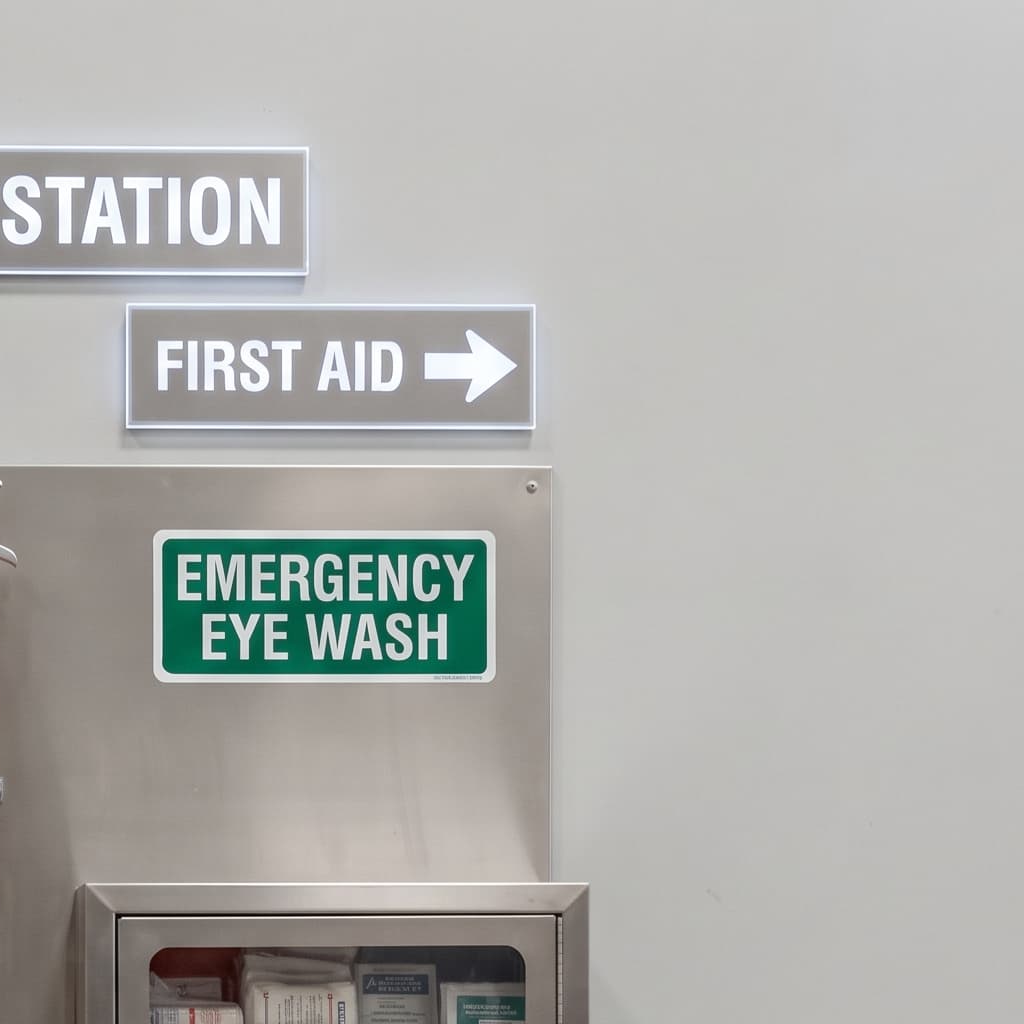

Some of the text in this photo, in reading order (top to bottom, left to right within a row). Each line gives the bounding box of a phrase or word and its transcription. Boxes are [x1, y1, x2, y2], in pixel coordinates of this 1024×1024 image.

[1, 175, 281, 246] STATION
[157, 340, 403, 393] FIRST AID
[177, 554, 474, 602] EMERGENCY
[202, 613, 448, 661] EYE WASH
